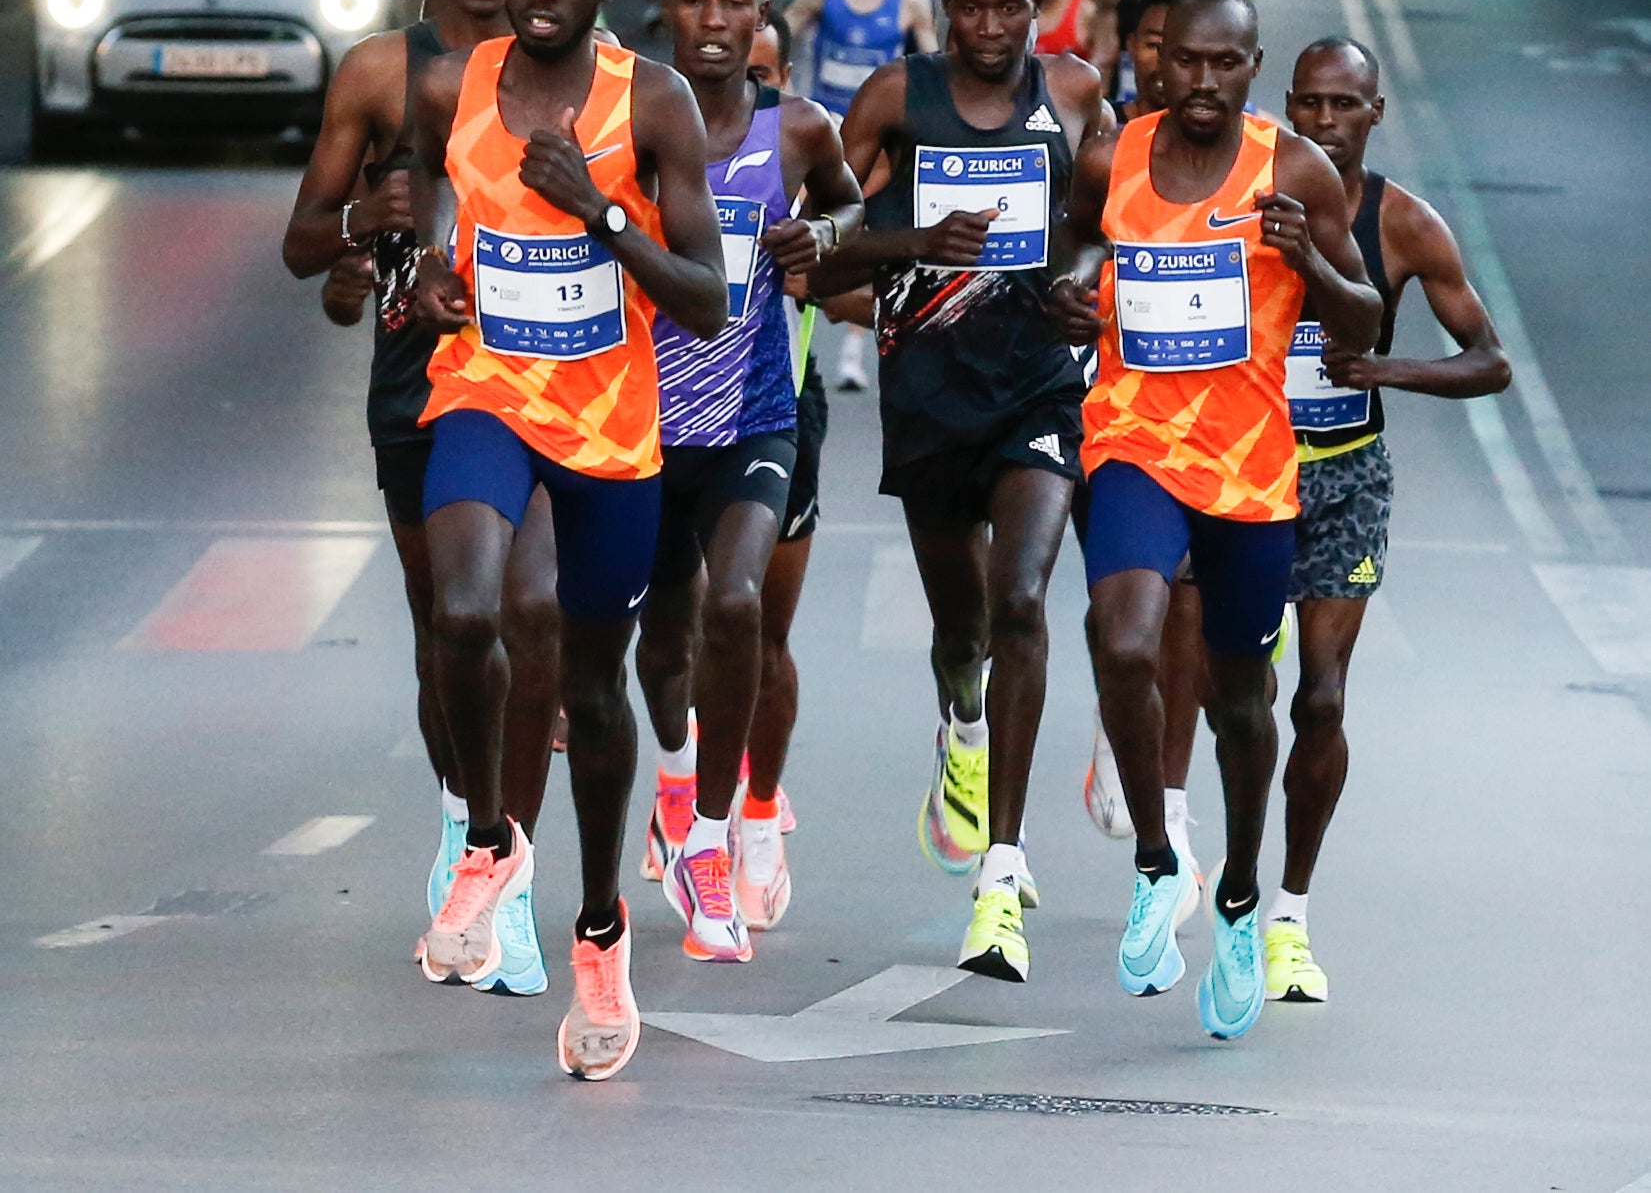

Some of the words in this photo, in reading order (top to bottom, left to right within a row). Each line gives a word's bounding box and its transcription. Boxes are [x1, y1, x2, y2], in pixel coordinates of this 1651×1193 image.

[1025, 121, 1062, 134] adidas
[967, 158, 1023, 172] ZURICH
[997, 196, 1009, 212] 6
[527, 243, 590, 261] ZURICH
[1157, 253, 1216, 269] ZURICH
[556, 283, 584, 301] 13
[1188, 293, 1204, 309] 4
[1029, 440, 1065, 465] adidas
